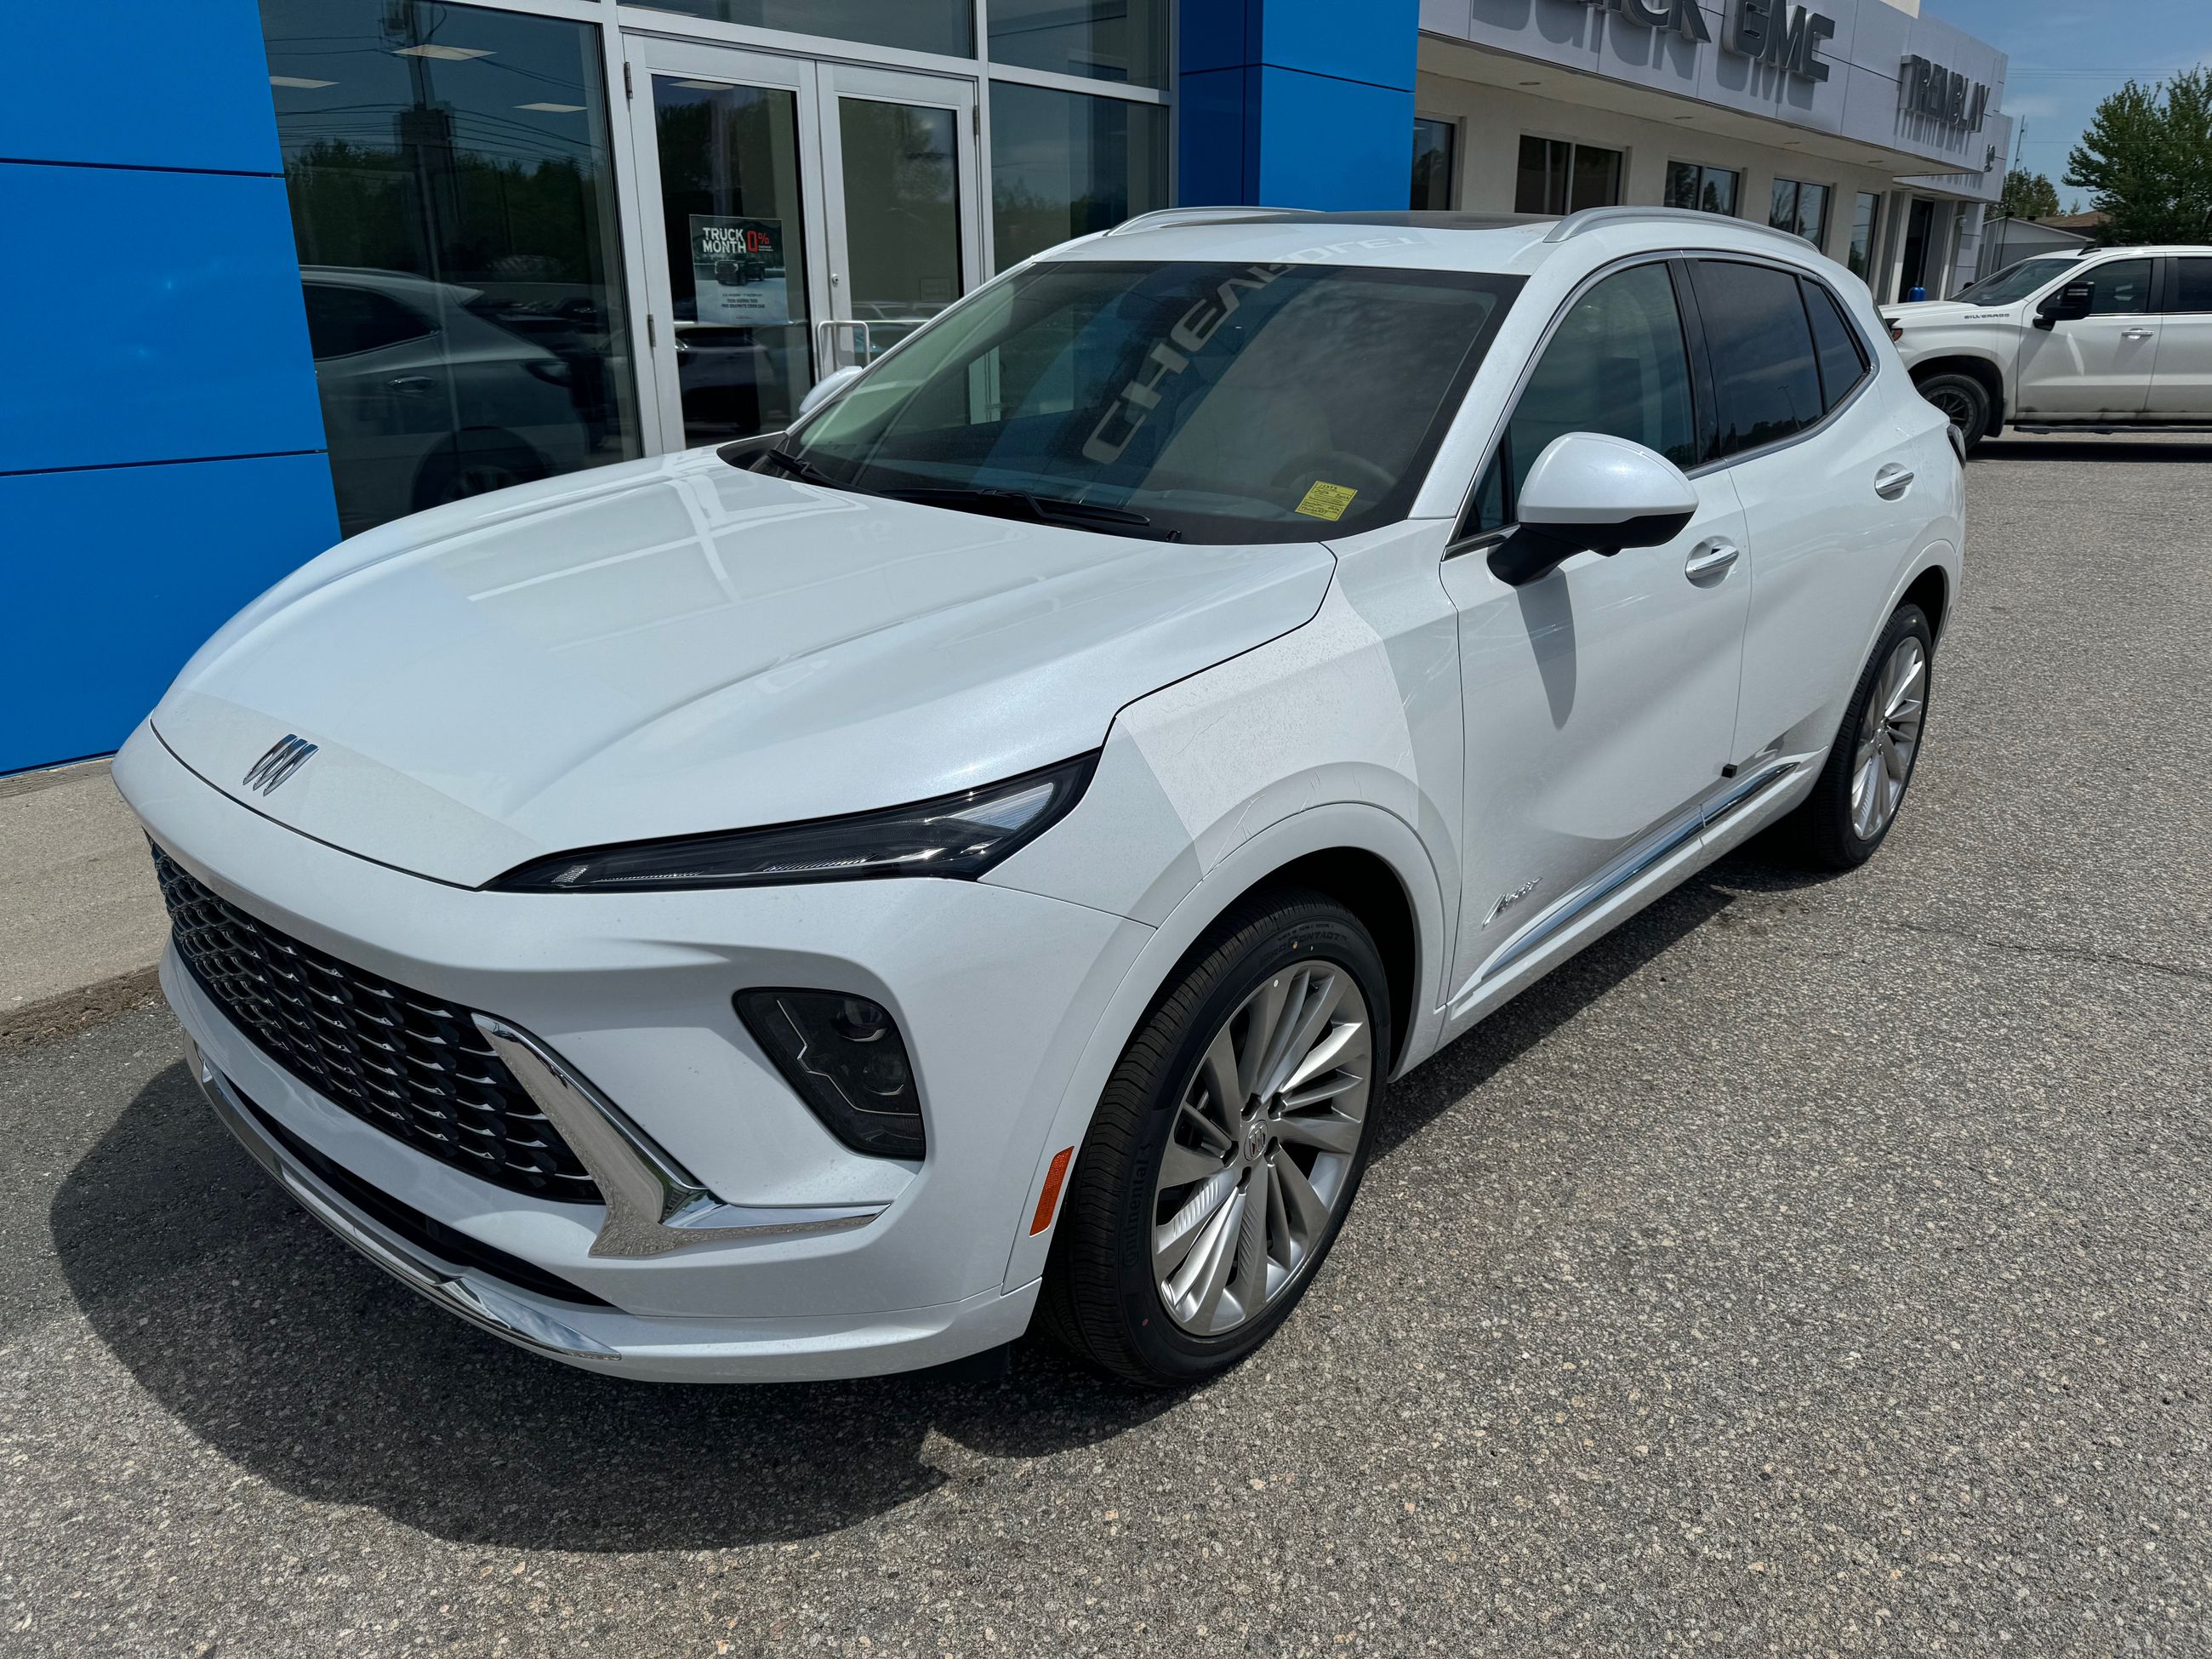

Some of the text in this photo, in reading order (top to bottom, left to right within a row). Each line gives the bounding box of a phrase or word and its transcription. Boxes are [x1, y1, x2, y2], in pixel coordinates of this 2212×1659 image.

[1899, 54, 1991, 133] TREMBLAY
[703, 227, 744, 242] TRUCK
[703, 239, 747, 254] MONTH
